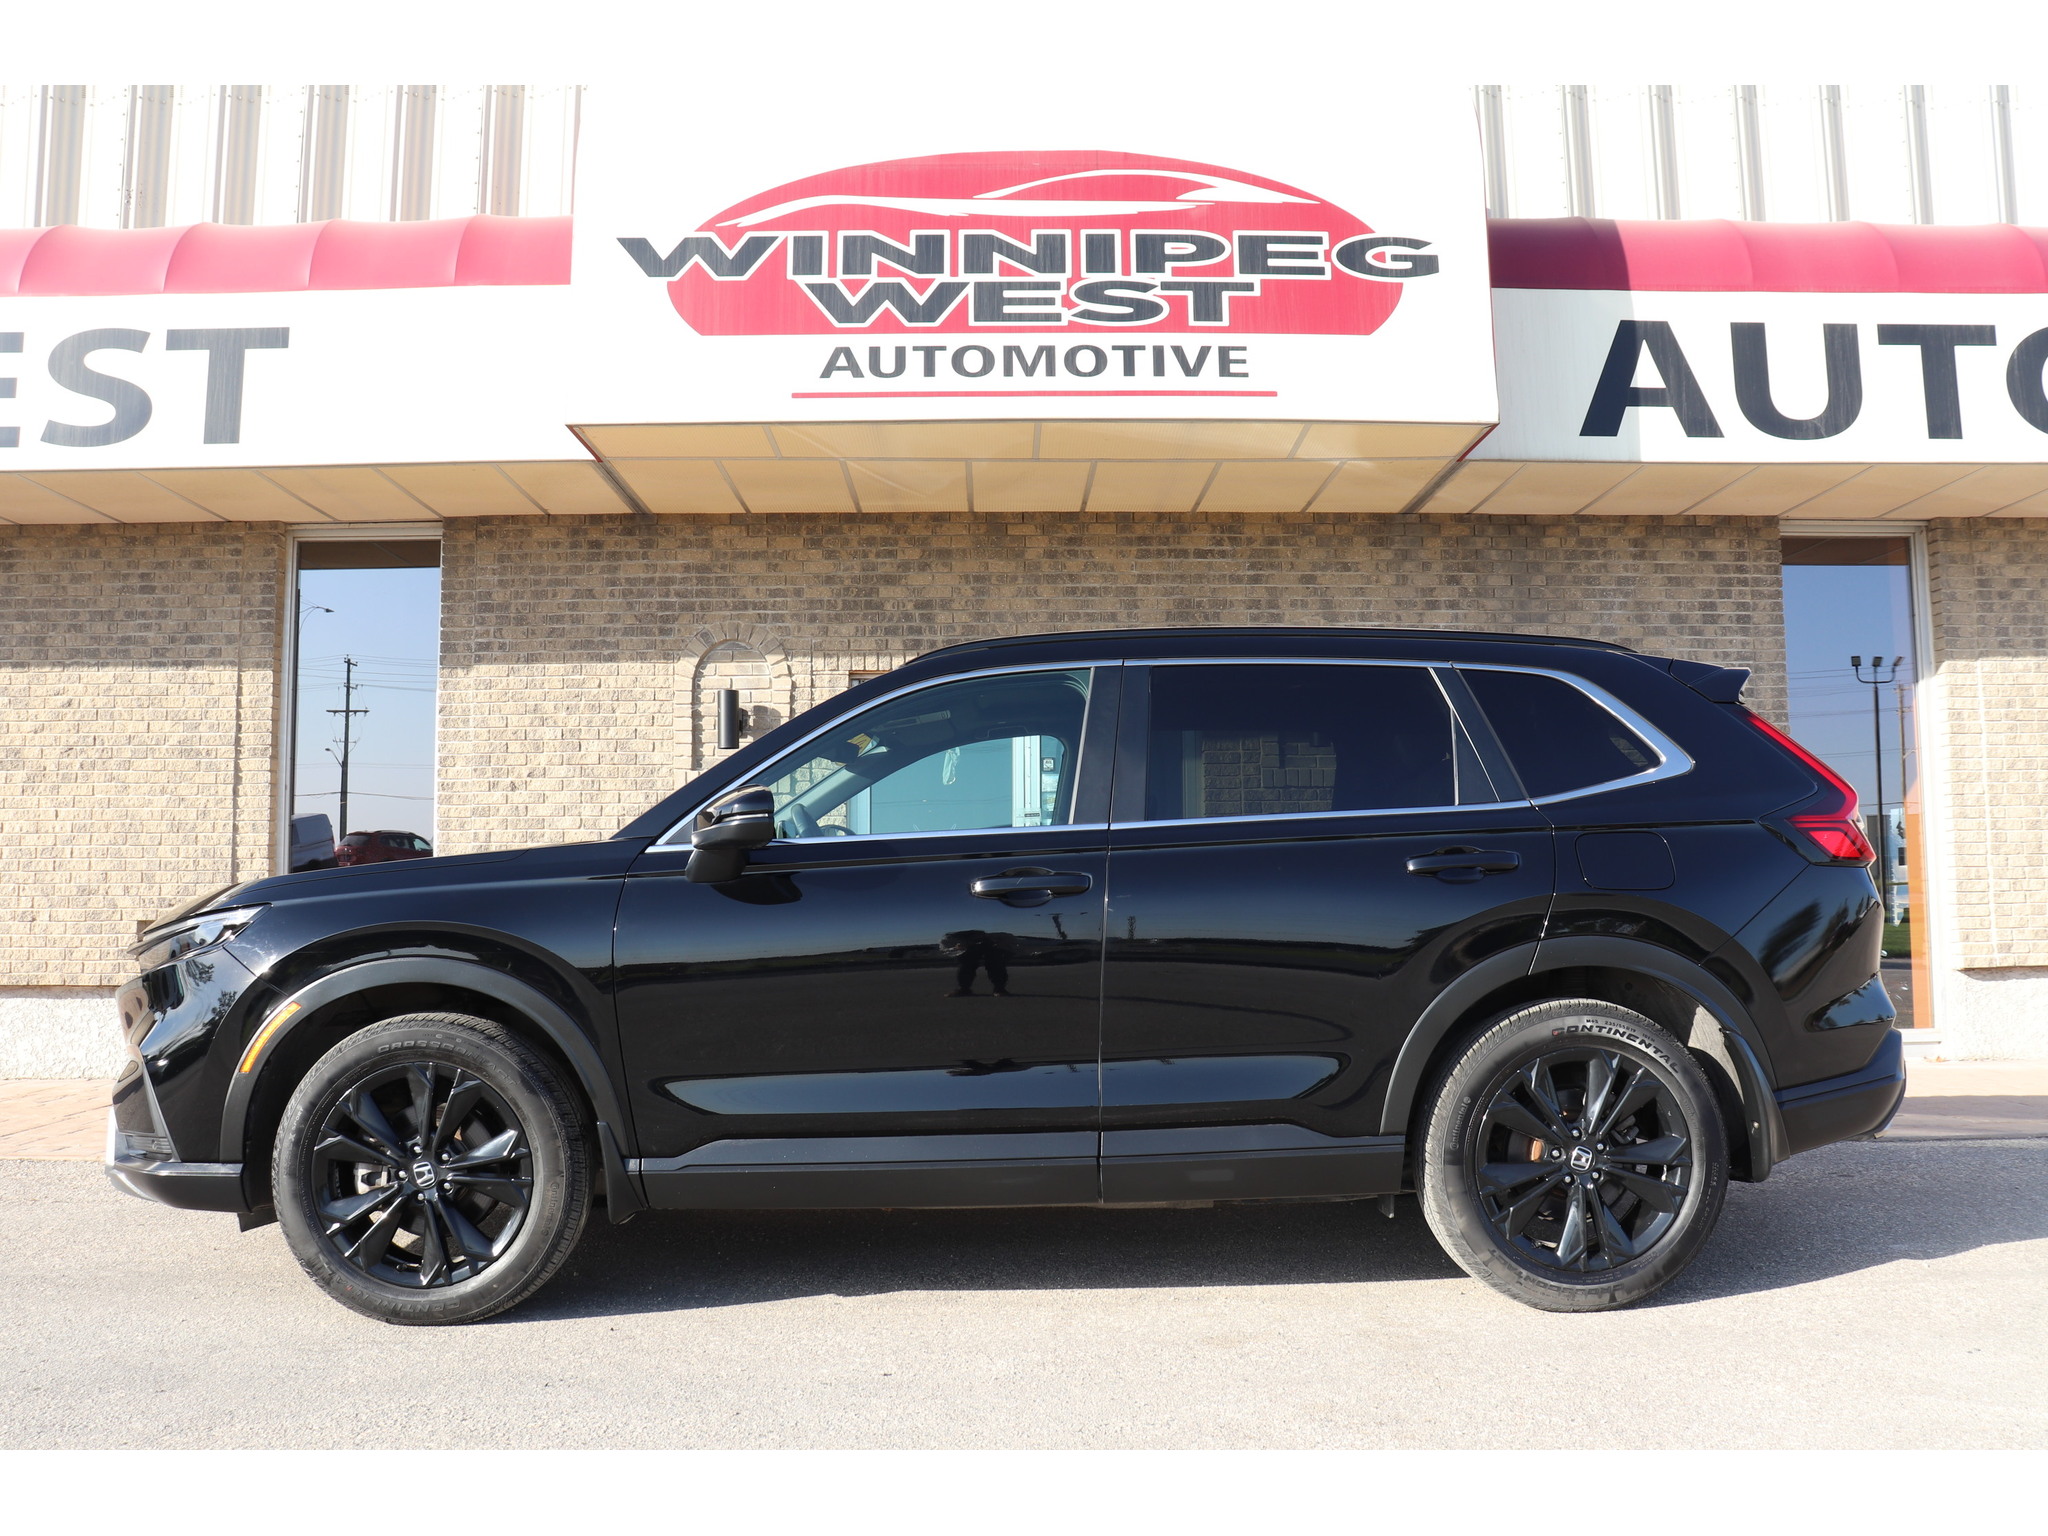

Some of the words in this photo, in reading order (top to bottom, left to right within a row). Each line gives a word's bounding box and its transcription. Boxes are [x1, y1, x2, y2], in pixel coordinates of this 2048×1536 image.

[616, 232, 1440, 278] WINNIPEG
[803, 281, 1254, 326] WEST
[819, 345, 1250, 379] AUTOMOTIVE
[1552, 1024, 1681, 1074] CONTINENTAL
[1450, 1102, 1470, 1150] Continental
